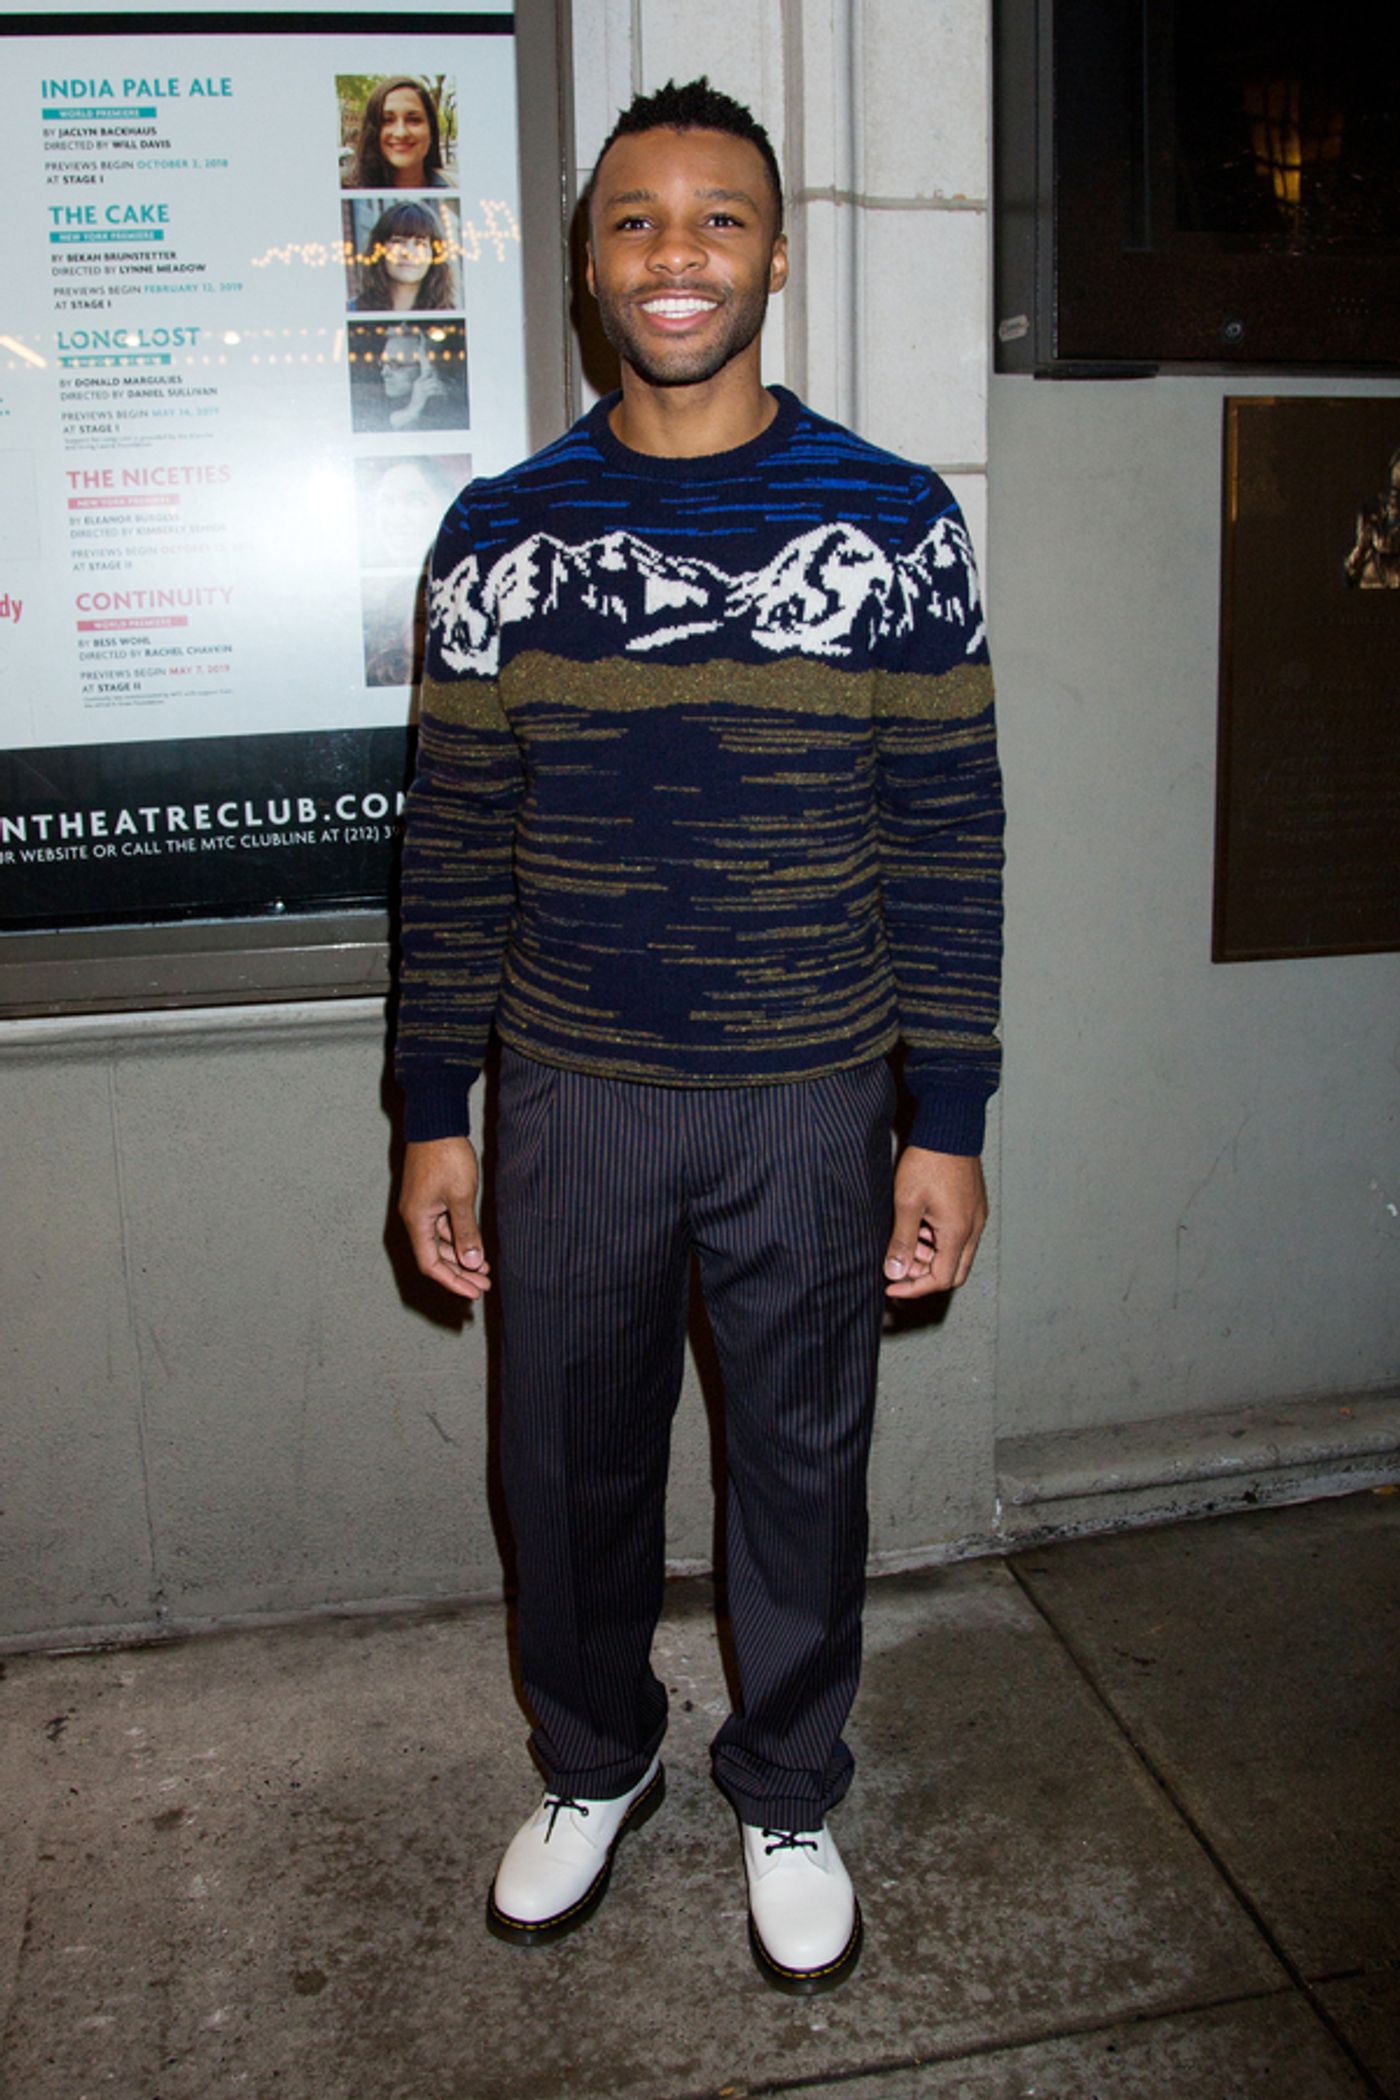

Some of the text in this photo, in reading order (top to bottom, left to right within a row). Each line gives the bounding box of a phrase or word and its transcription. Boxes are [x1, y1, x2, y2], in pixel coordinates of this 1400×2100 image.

[41, 77, 234, 99] INDIA PALE ALE
[59, 108, 139, 118] WORLD PREMIERE
[43, 126, 157, 138] BY JACLYN BACKHAUS
[44, 139, 171, 150] DIRECTED BY WILL DAVIS
[44, 161, 98, 171] PREVIEWS
[100, 160, 134, 170] BEGIN
[136, 159, 188, 169] OCTOBER
[46, 175, 59, 185] AT
[62, 174, 97, 184] STAGE
[49, 203, 170, 225] THE CAKE
[51, 251, 177, 263] BY BEKAH BRUNSTETTER
[51, 263, 207, 276] DIRECTED BY LYNNE MEADOW
[53, 286, 105, 296] PREVIEWS
[107, 285, 141, 295] BEGIN
[144, 283, 199, 294] FEBRUARY
[54, 301, 67, 310] AT
[70, 300, 105, 309] STAGE
[138, 327, 201, 349] LOST
[58, 379, 72, 389] BY
[74, 377, 120, 388] DONALD
[60, 386, 218, 401] DIRECTED BY DANIEL SULLIVAN
[61, 410, 114, 421] PREVIEWS
[116, 409, 149, 420] BEGIN
[63, 424, 77, 434] AT
[79, 424, 113, 434] STAGE
[65, 464, 231, 490] THE NICETIES
[69, 516, 82, 526] BY
[84, 514, 132, 525] ELEANOR
[70, 529, 118, 539] DIRECTED
[121, 528, 133, 537] BY
[70, 548, 122, 559] PREVIEWS
[125, 546, 158, 557] BEGIN
[72, 562, 86, 572] AT
[88, 561, 121, 571] STAGE
[75, 586, 235, 612] CONTINUITY
[0, 592, 23, 625] dy
[77, 636, 152, 648] BY BESS WOHL
[78, 651, 128, 662] DIRECTED
[130, 649, 143, 660] BY
[144, 647, 184, 658] RACHEL
[80, 670, 131, 681] PREVIEWS
[134, 667, 167, 679] BEGIN
[169, 665, 193, 676] MAY
[81, 684, 96, 694] AT
[97, 683, 130, 693] STAGE
[19, 845, 89, 863] WEBSITE
[93, 844, 118, 858] OR
[121, 841, 162, 857] CALL
[165, 838, 197, 853] THE
[201, 835, 236, 850] MTC
[240, 831, 316, 848] CLUBLINE
[321, 828, 340, 843] AT
[344, 826, 380, 843] (212)
